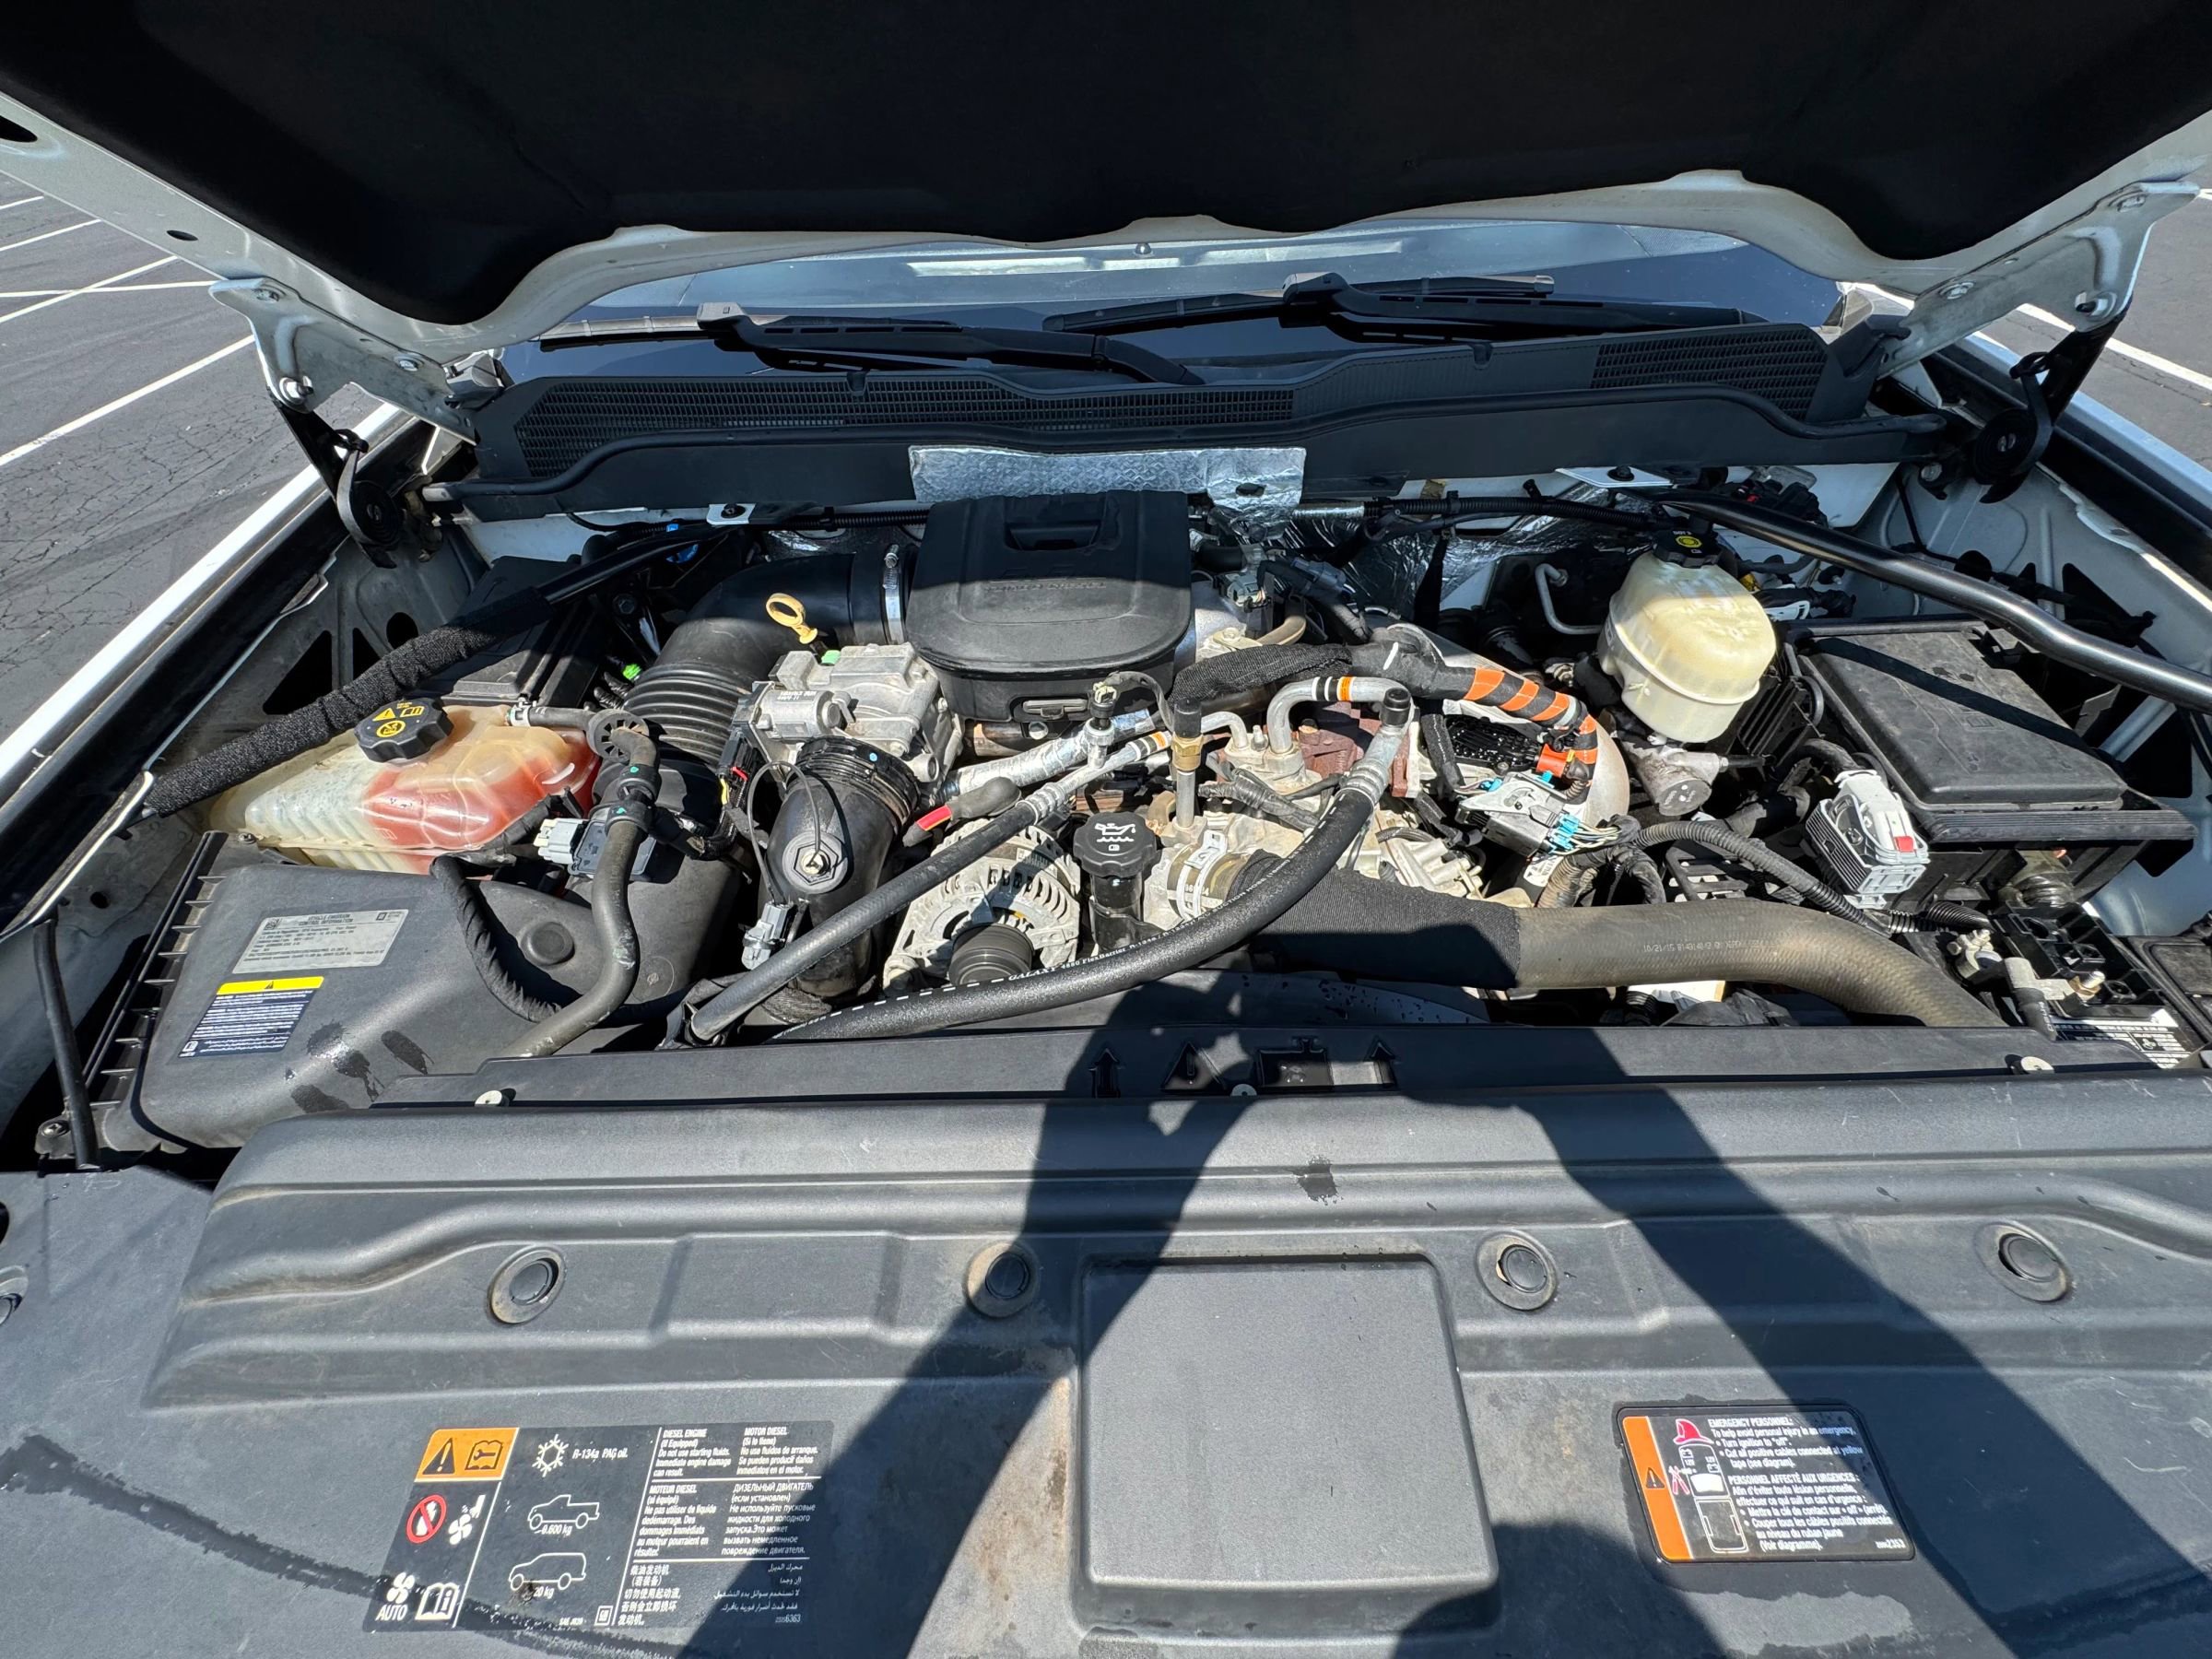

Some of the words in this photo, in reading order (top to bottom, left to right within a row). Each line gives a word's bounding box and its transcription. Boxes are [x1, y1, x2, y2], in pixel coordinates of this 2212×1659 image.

[1008, 968, 1057, 982] GALAXY
[1082, 947, 1126, 965] FlexBarrier
[1213, 891, 1246, 913] SUCTION
[1707, 1418, 1750, 1428] EMERGENCY
[663, 1429, 684, 1438] DIESEL
[684, 1428, 708, 1438] ENGINE
[744, 1427, 767, 1436] MOTOR
[766, 1426, 788, 1436] DIESEL
[1754, 1427, 1783, 1438] personal
[668, 1438, 699, 1449] Equipped)
[1721, 1438, 1738, 1448] Turn
[1737, 1438, 1764, 1449] ignition
[571, 1448, 600, 1459] R-134a
[601, 1447, 618, 1459] PAG
[658, 1449, 667, 1457] Do
[666, 1448, 677, 1457] not
[677, 1449, 689, 1457] use
[688, 1447, 712, 1458] starting
[740, 1447, 749, 1455] No
[782, 1446, 791, 1454] de
[1747, 1447, 1775, 1459] positive
[1773, 1447, 1798, 1456] cables
[1796, 1445, 1834, 1456] connected
[1841, 1445, 1864, 1456] yellow
[655, 1458, 687, 1467] Immediate
[687, 1458, 708, 1468] engine
[707, 1457, 732, 1467] damage
[738, 1456, 747, 1465] Se
[747, 1456, 770, 1466] pueden
[770, 1455, 795, 1466] producir
[736, 1466, 770, 1476] inmediatos
[770, 1466, 778, 1475] en
[778, 1465, 785, 1475] el
[1727, 1475, 1771, 1485] PERSONNEL
[649, 1485, 676, 1494] MOTEUR
[675, 1484, 698, 1494] DIESEL
[733, 1482, 775, 1493] ДИЗЕЛЬНЫЙ
[775, 1482, 814, 1492] ДВИГАТЕЛЬ
[644, 1506, 653, 1514] Ne
[653, 1506, 665, 1516] pas
[665, 1505, 688, 1514] utiliser
[687, 1504, 696, 1514] de
[696, 1504, 717, 1515] liquide
[730, 1504, 740, 1512] Не
[740, 1504, 782, 1513] используйте
[783, 1504, 816, 1512] пусковые
[683, 1515, 696, 1524] Des
[727, 1515, 760, 1524] жидкости
[760, 1515, 774, 1524] для
[562, 1524, 572, 1536] kg
[639, 1526, 673, 1537] dommages
[636, 1538, 646, 1547] au
[645, 1537, 668, 1547] moteur
[667, 1535, 700, 1547] pourraient
[700, 1537, 709, 1546] en
[752, 1535, 798, 1544] немедленное
[722, 1547, 769, 1556] повреждение
[544, 1586, 554, 1599] kg
[375, 1604, 407, 1621] AUTO
